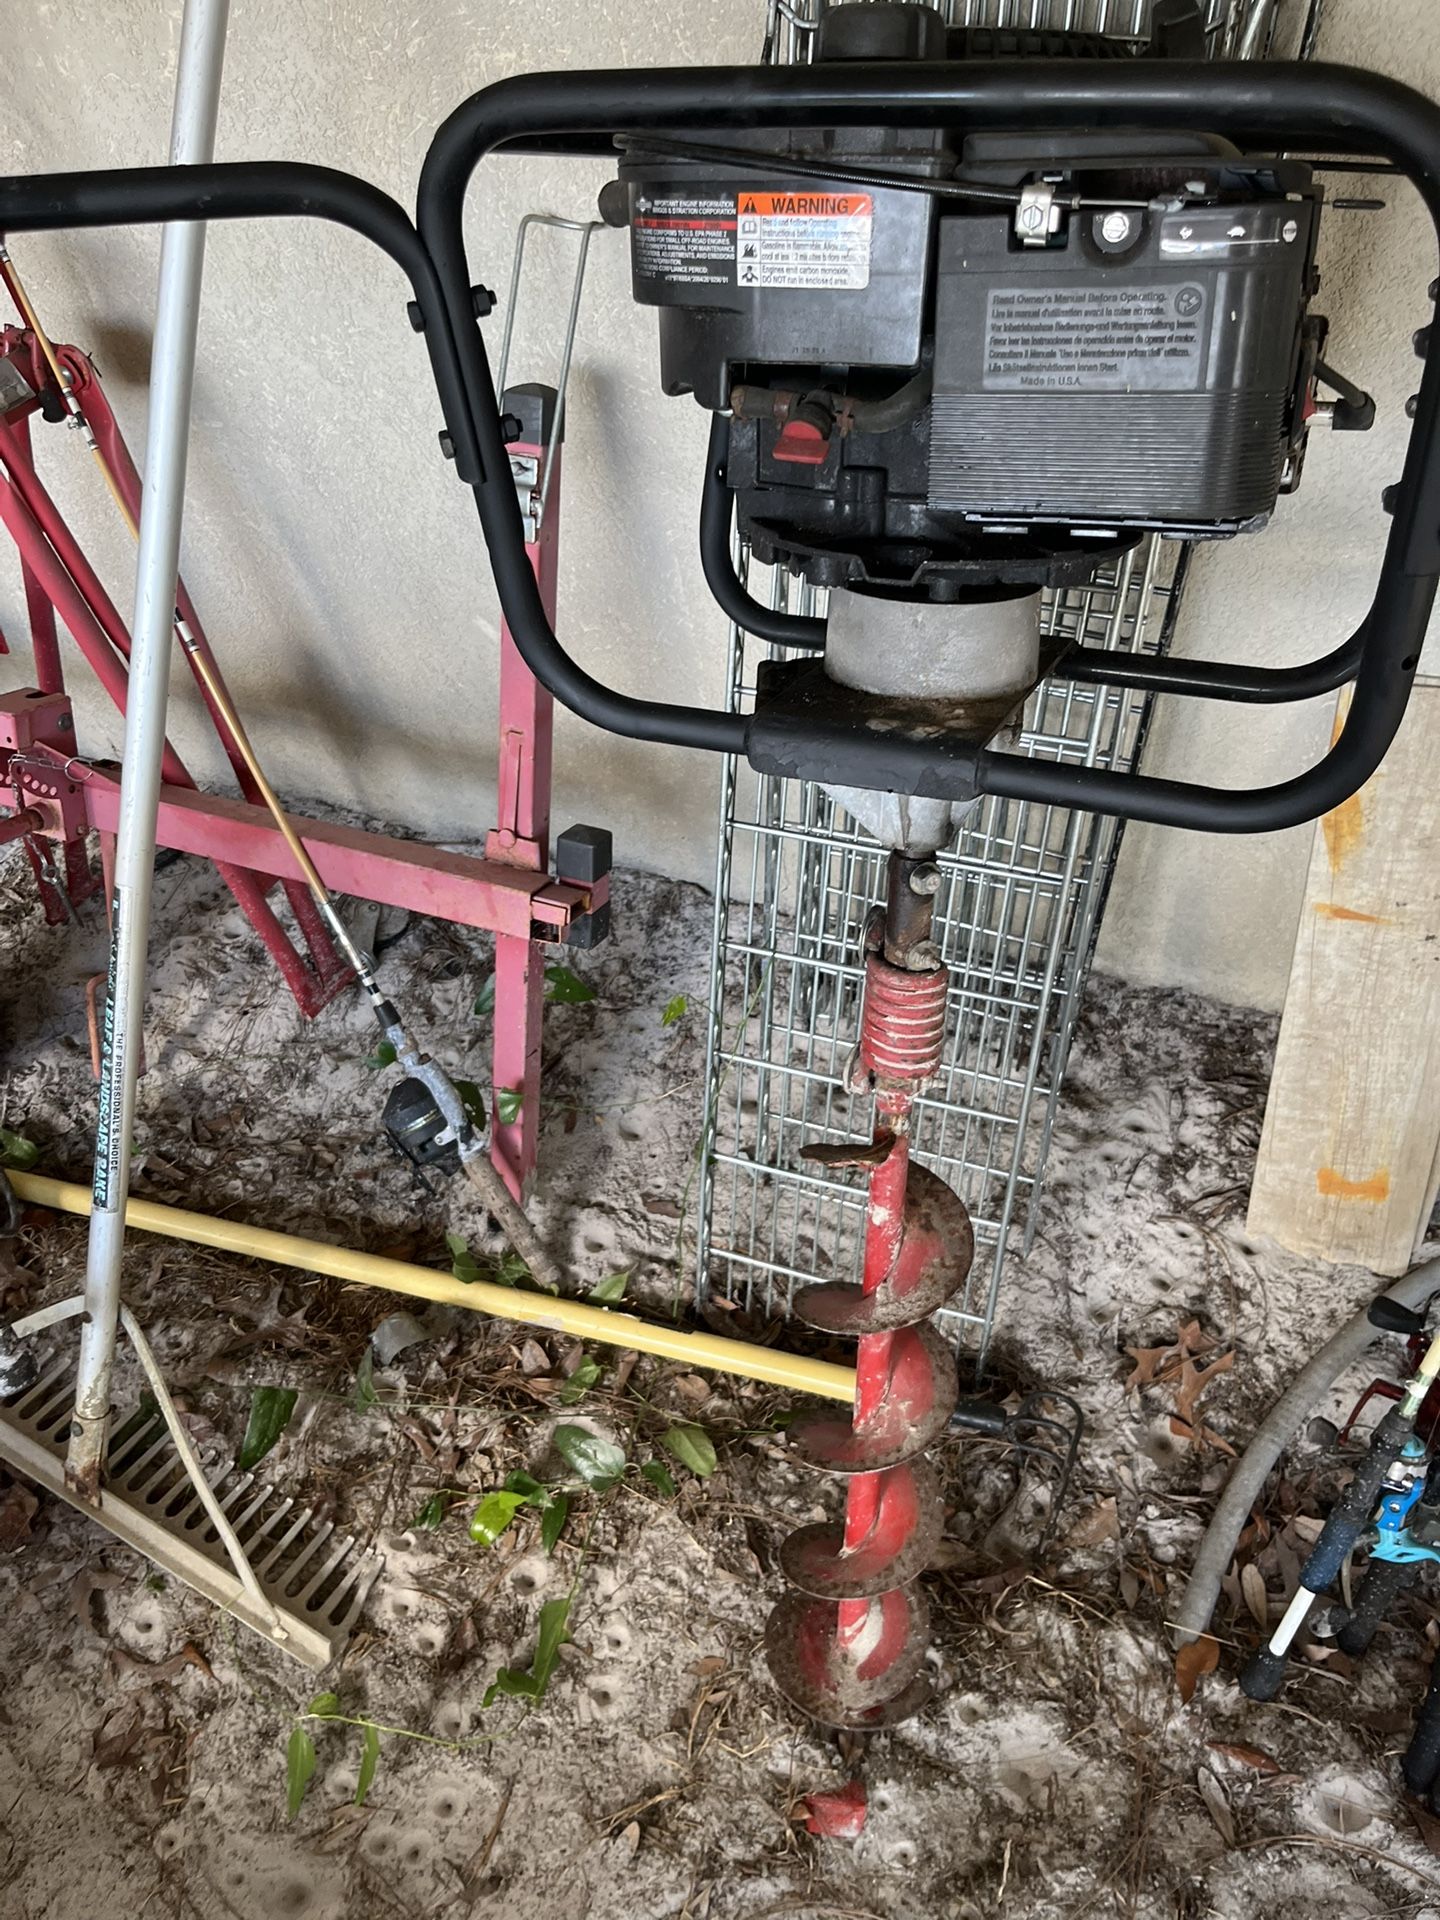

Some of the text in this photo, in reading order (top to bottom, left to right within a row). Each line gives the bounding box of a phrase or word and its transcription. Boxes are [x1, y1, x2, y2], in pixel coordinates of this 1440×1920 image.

[680, 200, 698, 208] ENGINE
[698, 200, 734, 208] INFORMATION
[771, 198, 849, 214] WARNING
[652, 206, 668, 214] BRIGGS
[763, 218, 778, 226] Read
[790, 218, 808, 226] follow
[762, 241, 784, 250] Gasoline
[762, 252, 773, 260] cool
[762, 266, 784, 276] Engines
[786, 266, 798, 274] emit
[800, 266, 819, 274] carbon
[762, 276, 772, 284] DO
[773, 276, 786, 284] NOT
[788, 276, 798, 284] run
[805, 276, 833, 284] enclosed
[993, 292, 1167, 304] Read Owner's Manual Before Operating.
[1020, 376, 1045, 386] Made
[1047, 376, 1056, 386] in
[104, 997, 114, 1041] LEAF
[102, 1041, 112, 1056] &
[97, 1057, 112, 1155] LANDSCAPE
[110, 1033, 124, 1171] THE PROFESSIONAL'S CHOICE
[94, 1158, 108, 1201] RAKE
